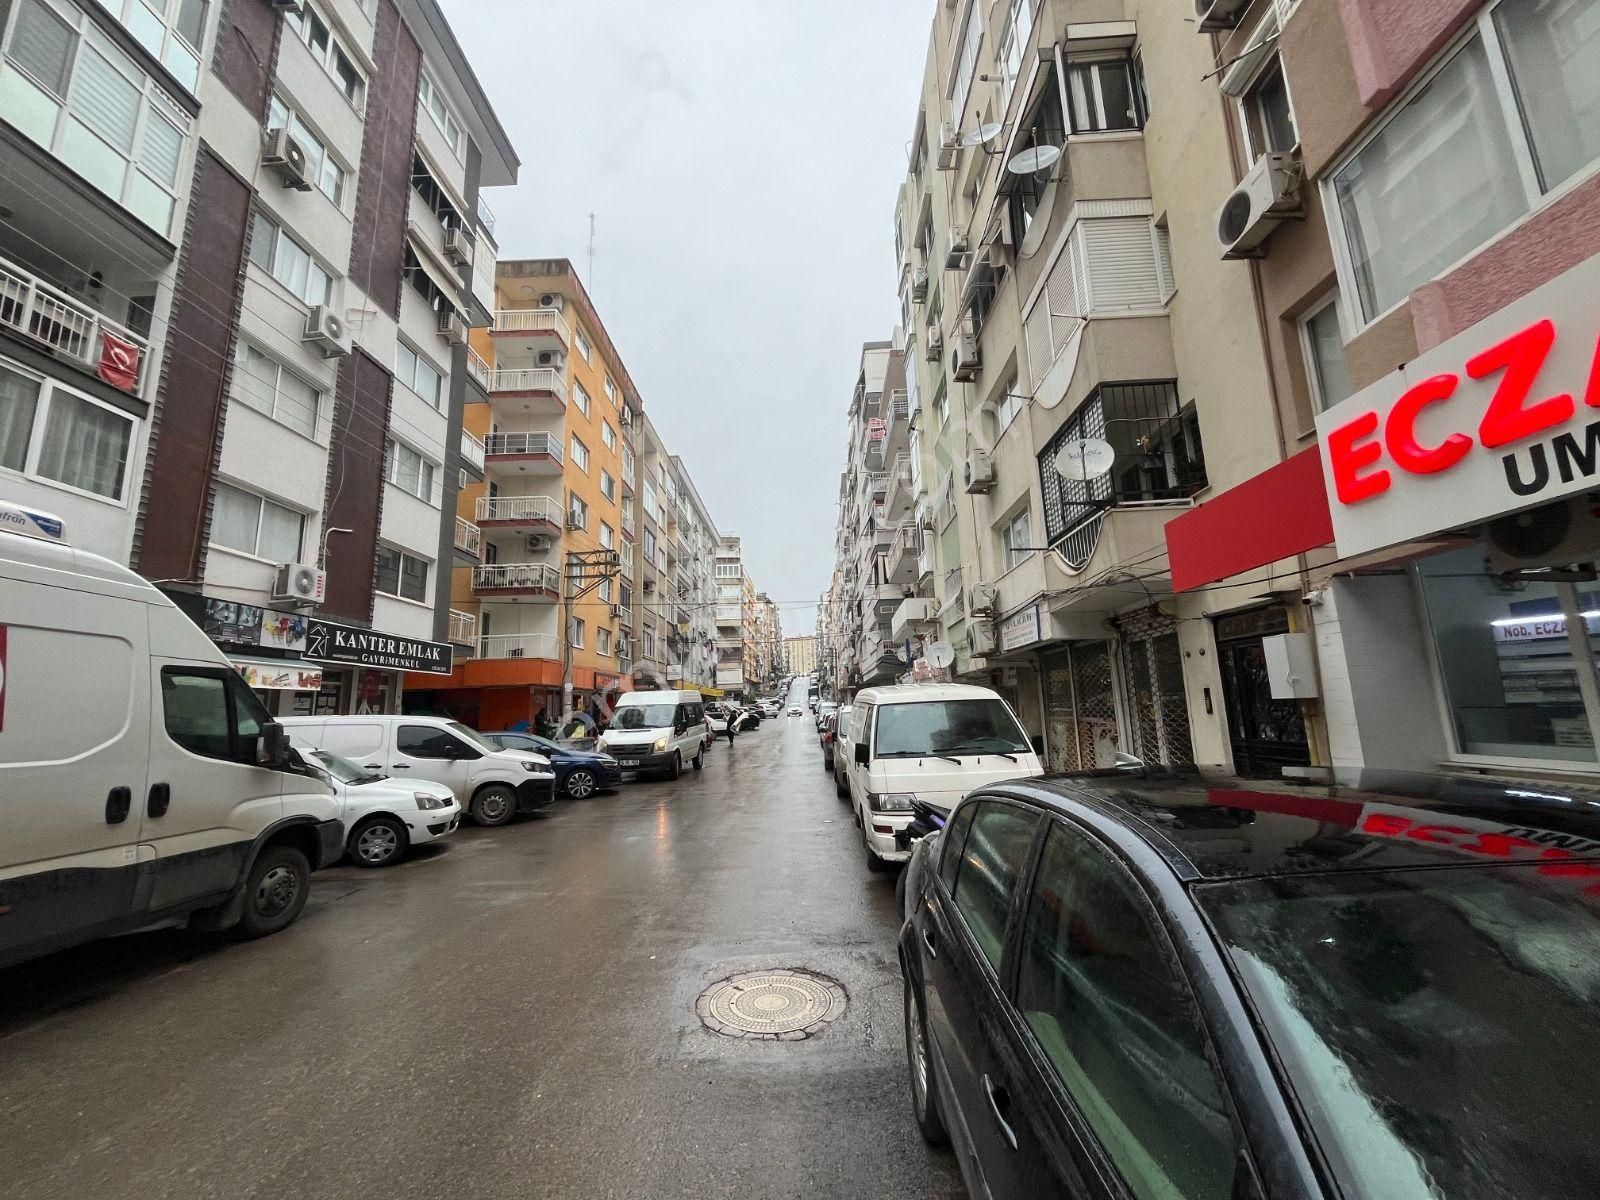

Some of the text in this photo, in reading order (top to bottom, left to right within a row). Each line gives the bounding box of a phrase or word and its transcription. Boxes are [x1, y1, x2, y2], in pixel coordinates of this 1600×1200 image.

[1327, 312, 1600, 504] ECZ
[334, 630, 441, 660] KANTER EMLAK
[1503, 626, 1532, 638] Nob.
